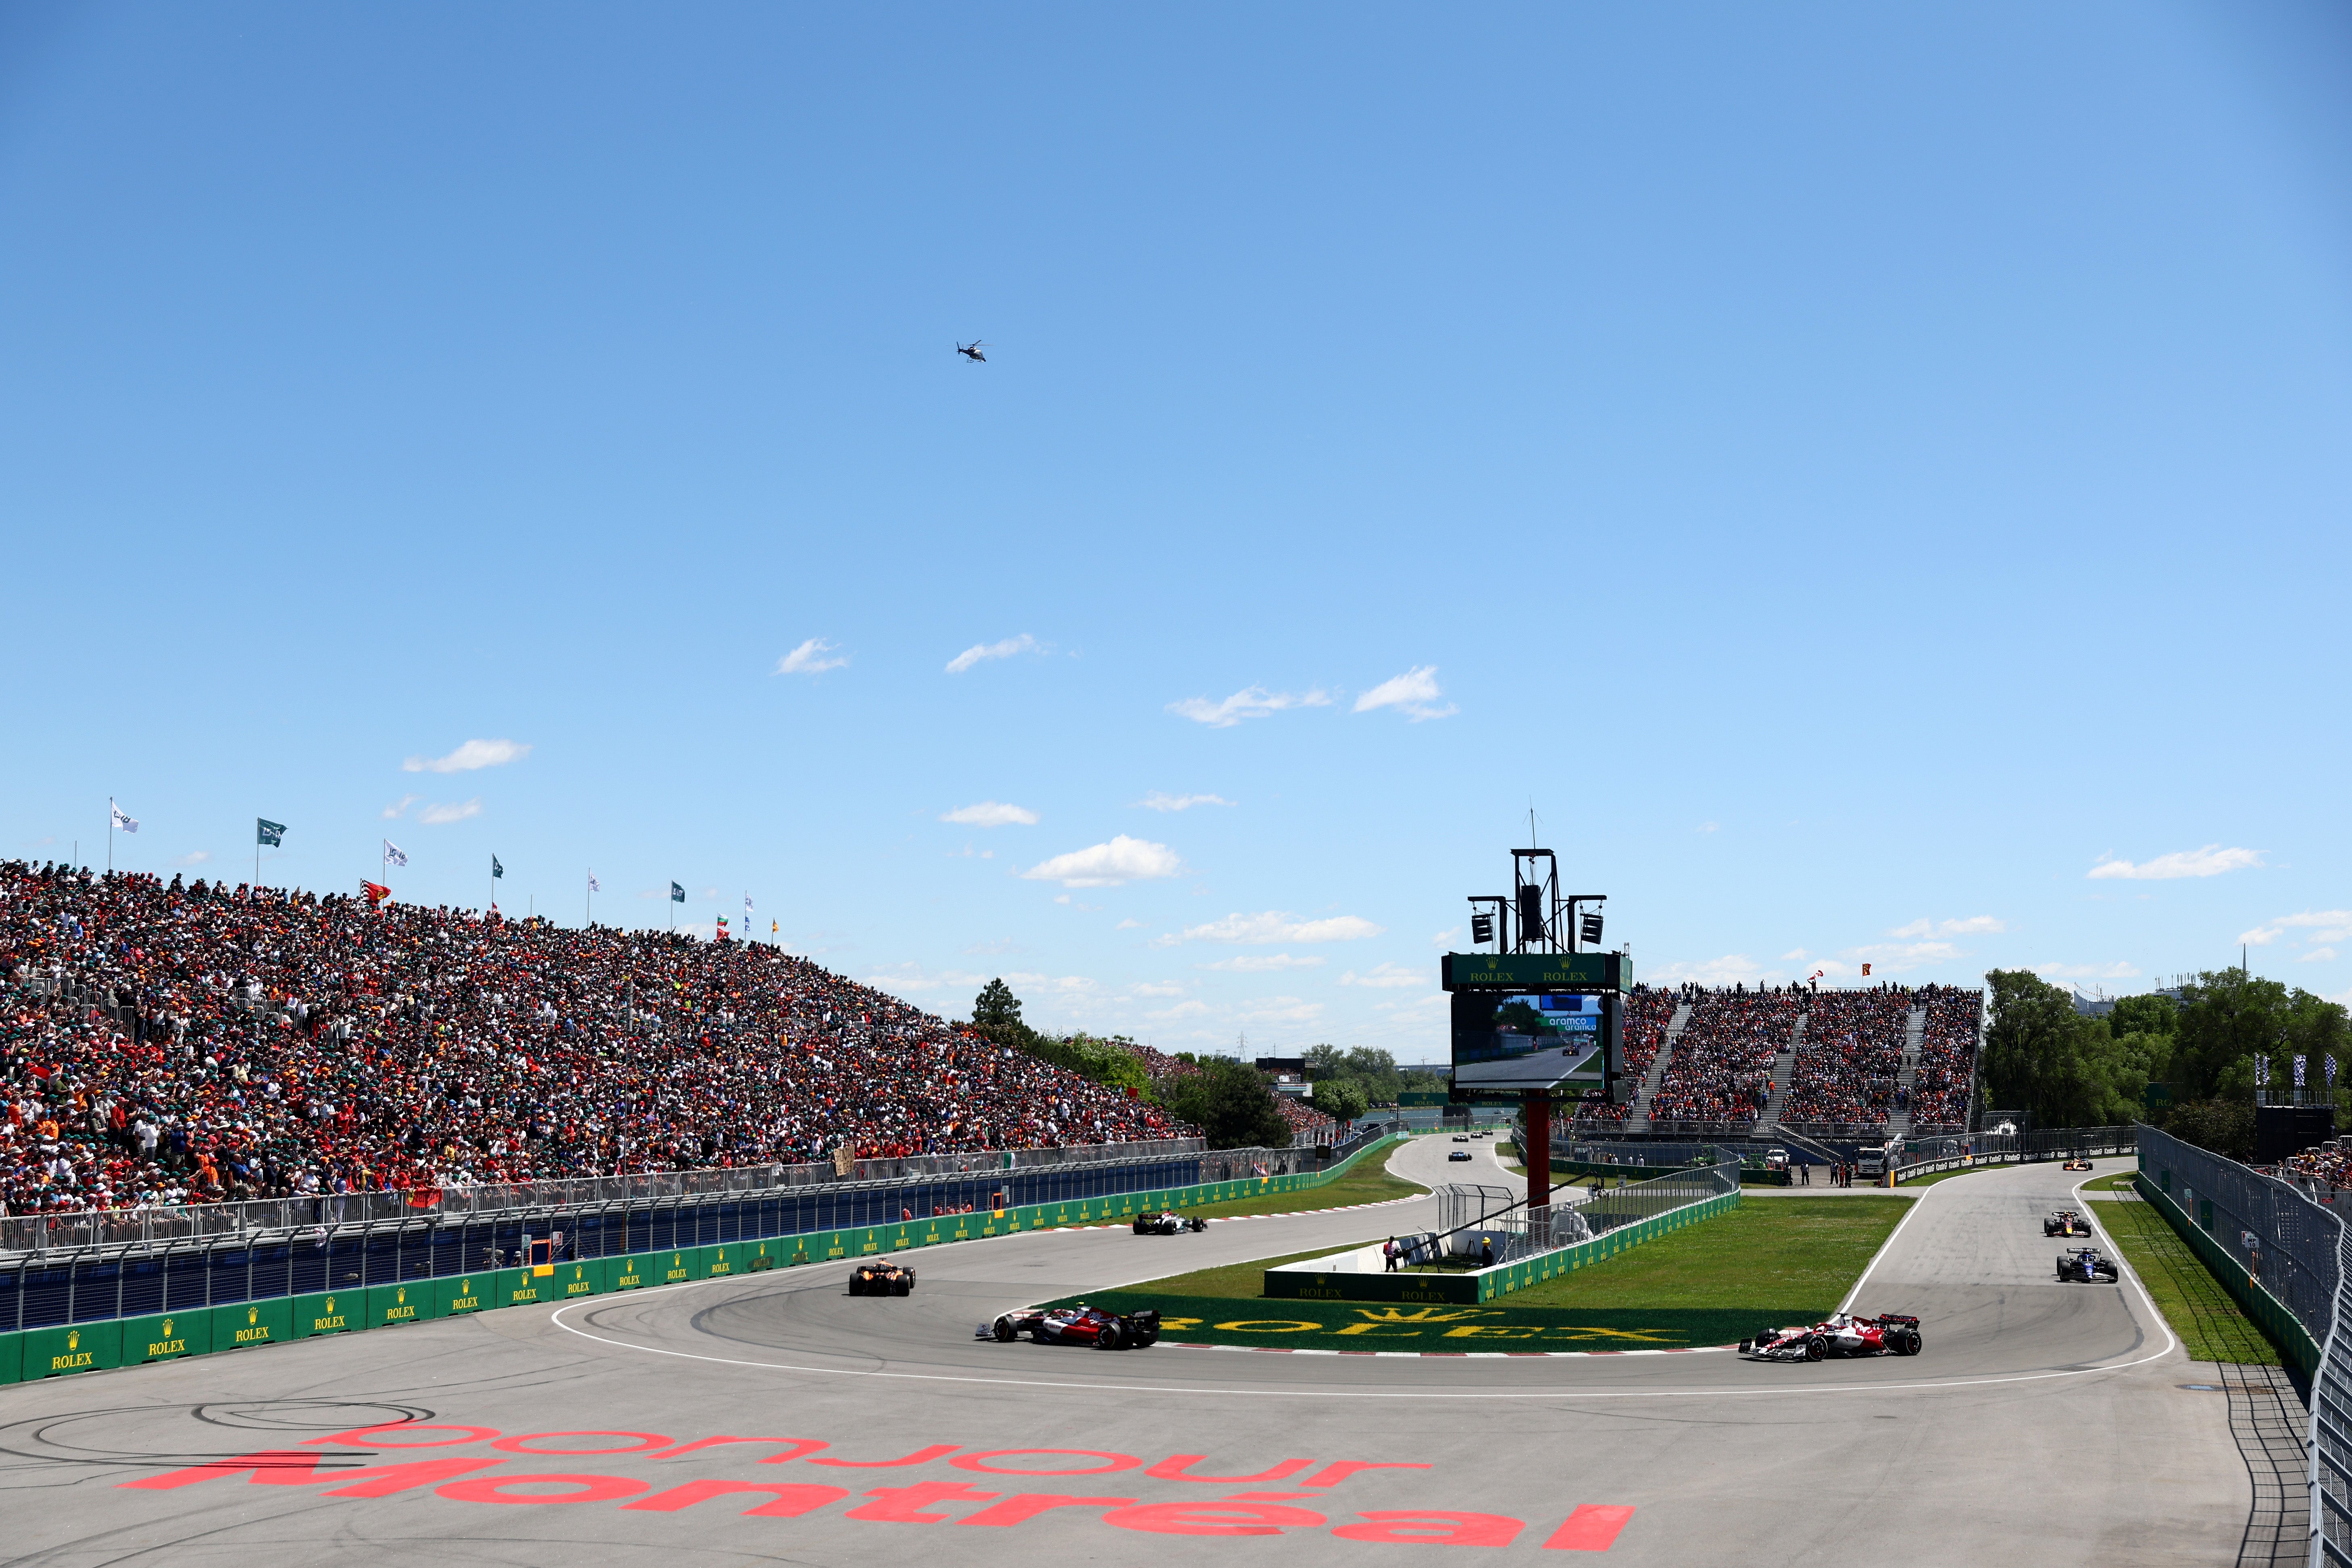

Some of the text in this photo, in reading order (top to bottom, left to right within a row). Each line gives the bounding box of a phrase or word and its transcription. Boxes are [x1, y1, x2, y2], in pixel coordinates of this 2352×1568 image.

[1470, 972, 1514, 981] ROLEX
[1543, 972, 1587, 981] ROLEX
[1009, 1222, 1020, 1230] ROLEX
[927, 1234, 939, 1242] ROLEX
[955, 1230, 968, 1238] ROLEX
[863, 1243, 877, 1251] ROLEX
[896, 1238, 909, 1247] ROLEX
[792, 1252, 808, 1261] ROLEX
[829, 1247, 843, 1256] ROLEX
[754, 1258, 770, 1267] ROLEX
[712, 1263, 730, 1273] ROLEX
[668, 1268, 686, 1279] ROLEX
[619, 1275, 640, 1286] ROLEX
[568, 1282, 590, 1293] ROLEX
[513, 1289, 537, 1301] ROLEX
[1300, 1288, 1342, 1298] ROLEX
[1402, 1291, 1446, 1301] ROLEX
[453, 1297, 478, 1309] ROLEX
[387, 1306, 415, 1319] ROLEX
[315, 1316, 345, 1330] ROLEX
[236, 1326, 269, 1342] ROLEX
[149, 1339, 185, 1356] ROLEX
[52, 1352, 92, 1370] ROLEX
[114, 1449, 1636, 1551] Montréal
